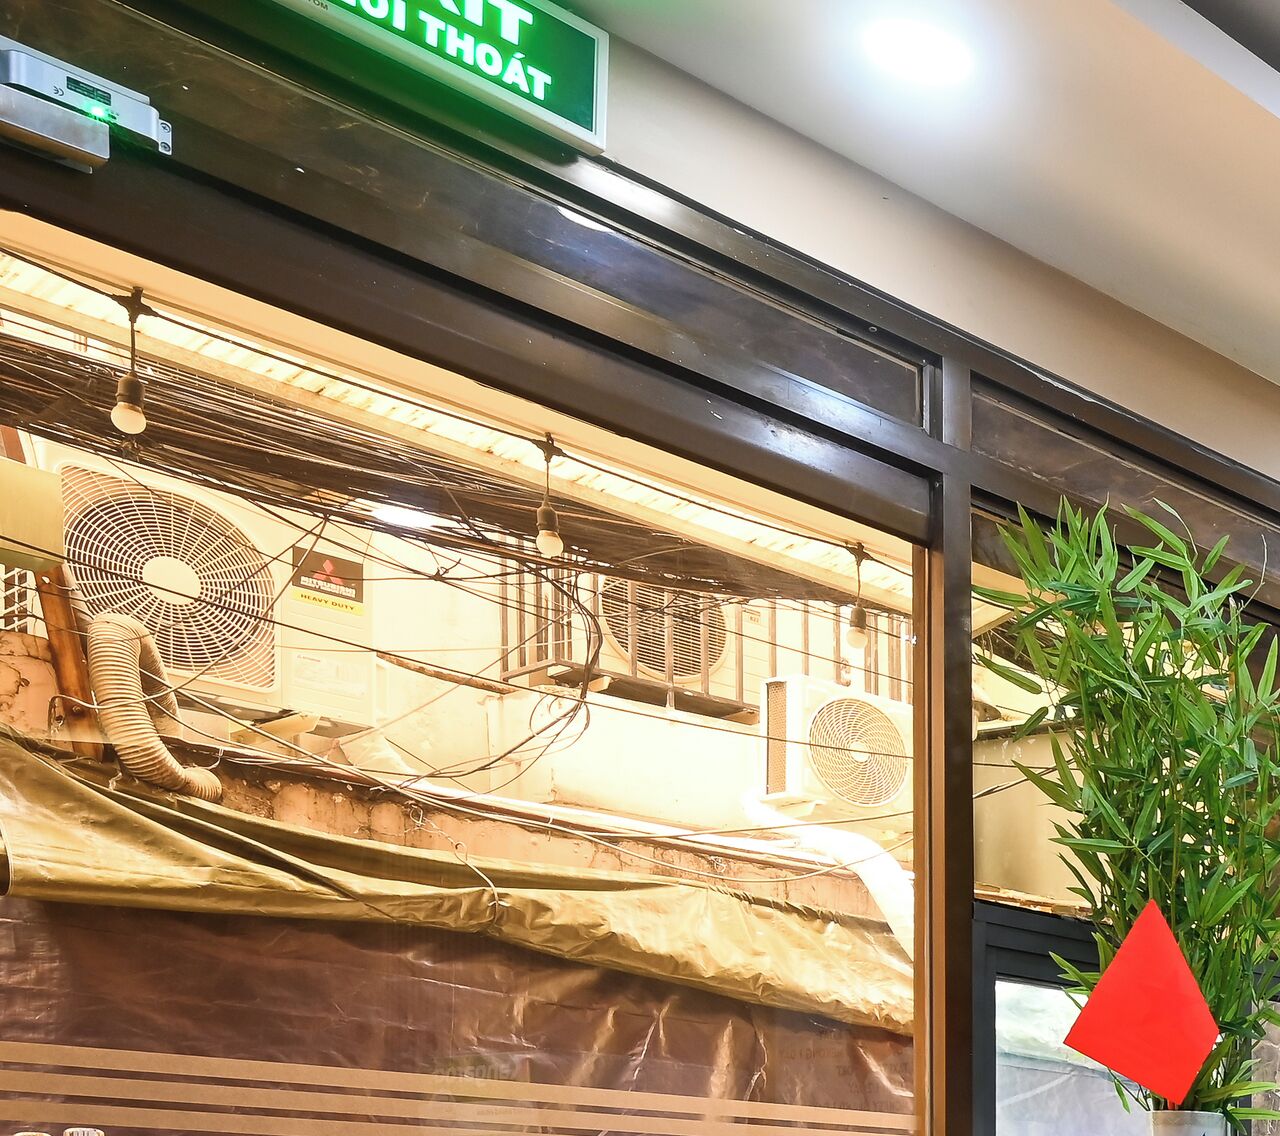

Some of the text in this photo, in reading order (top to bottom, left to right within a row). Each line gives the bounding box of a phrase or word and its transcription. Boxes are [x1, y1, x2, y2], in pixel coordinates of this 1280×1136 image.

[417, 10, 552, 101] THOÁT
[300, 594, 355, 611] HEAVY DUTY
